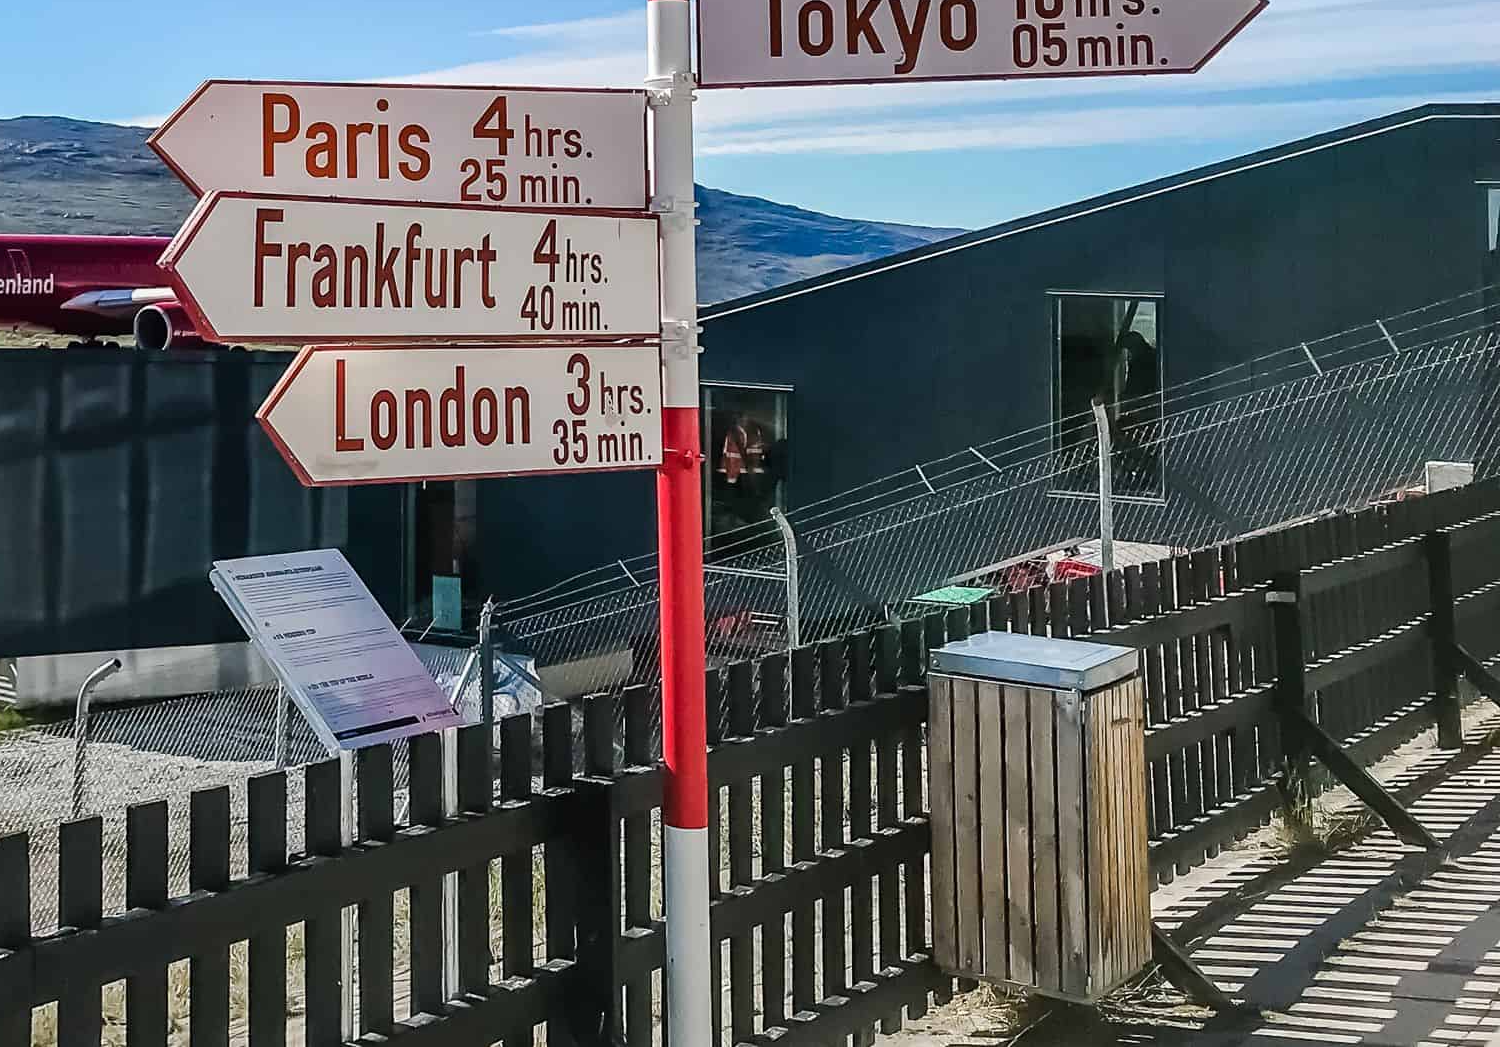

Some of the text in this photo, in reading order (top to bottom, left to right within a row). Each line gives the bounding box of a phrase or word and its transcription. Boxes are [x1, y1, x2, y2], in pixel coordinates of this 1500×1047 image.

[1012, 22, 1169, 69] 05 min.
[262, 93, 593, 182] Paris 4 hrs.
[460, 158, 593, 204] 25 min.
[253, 207, 608, 309] Frankfurt 4 hrs.
[520, 285, 608, 331] 40 min.
[335, 353, 651, 453] London 3 hrs.
[552, 419, 651, 466] 35 min.
